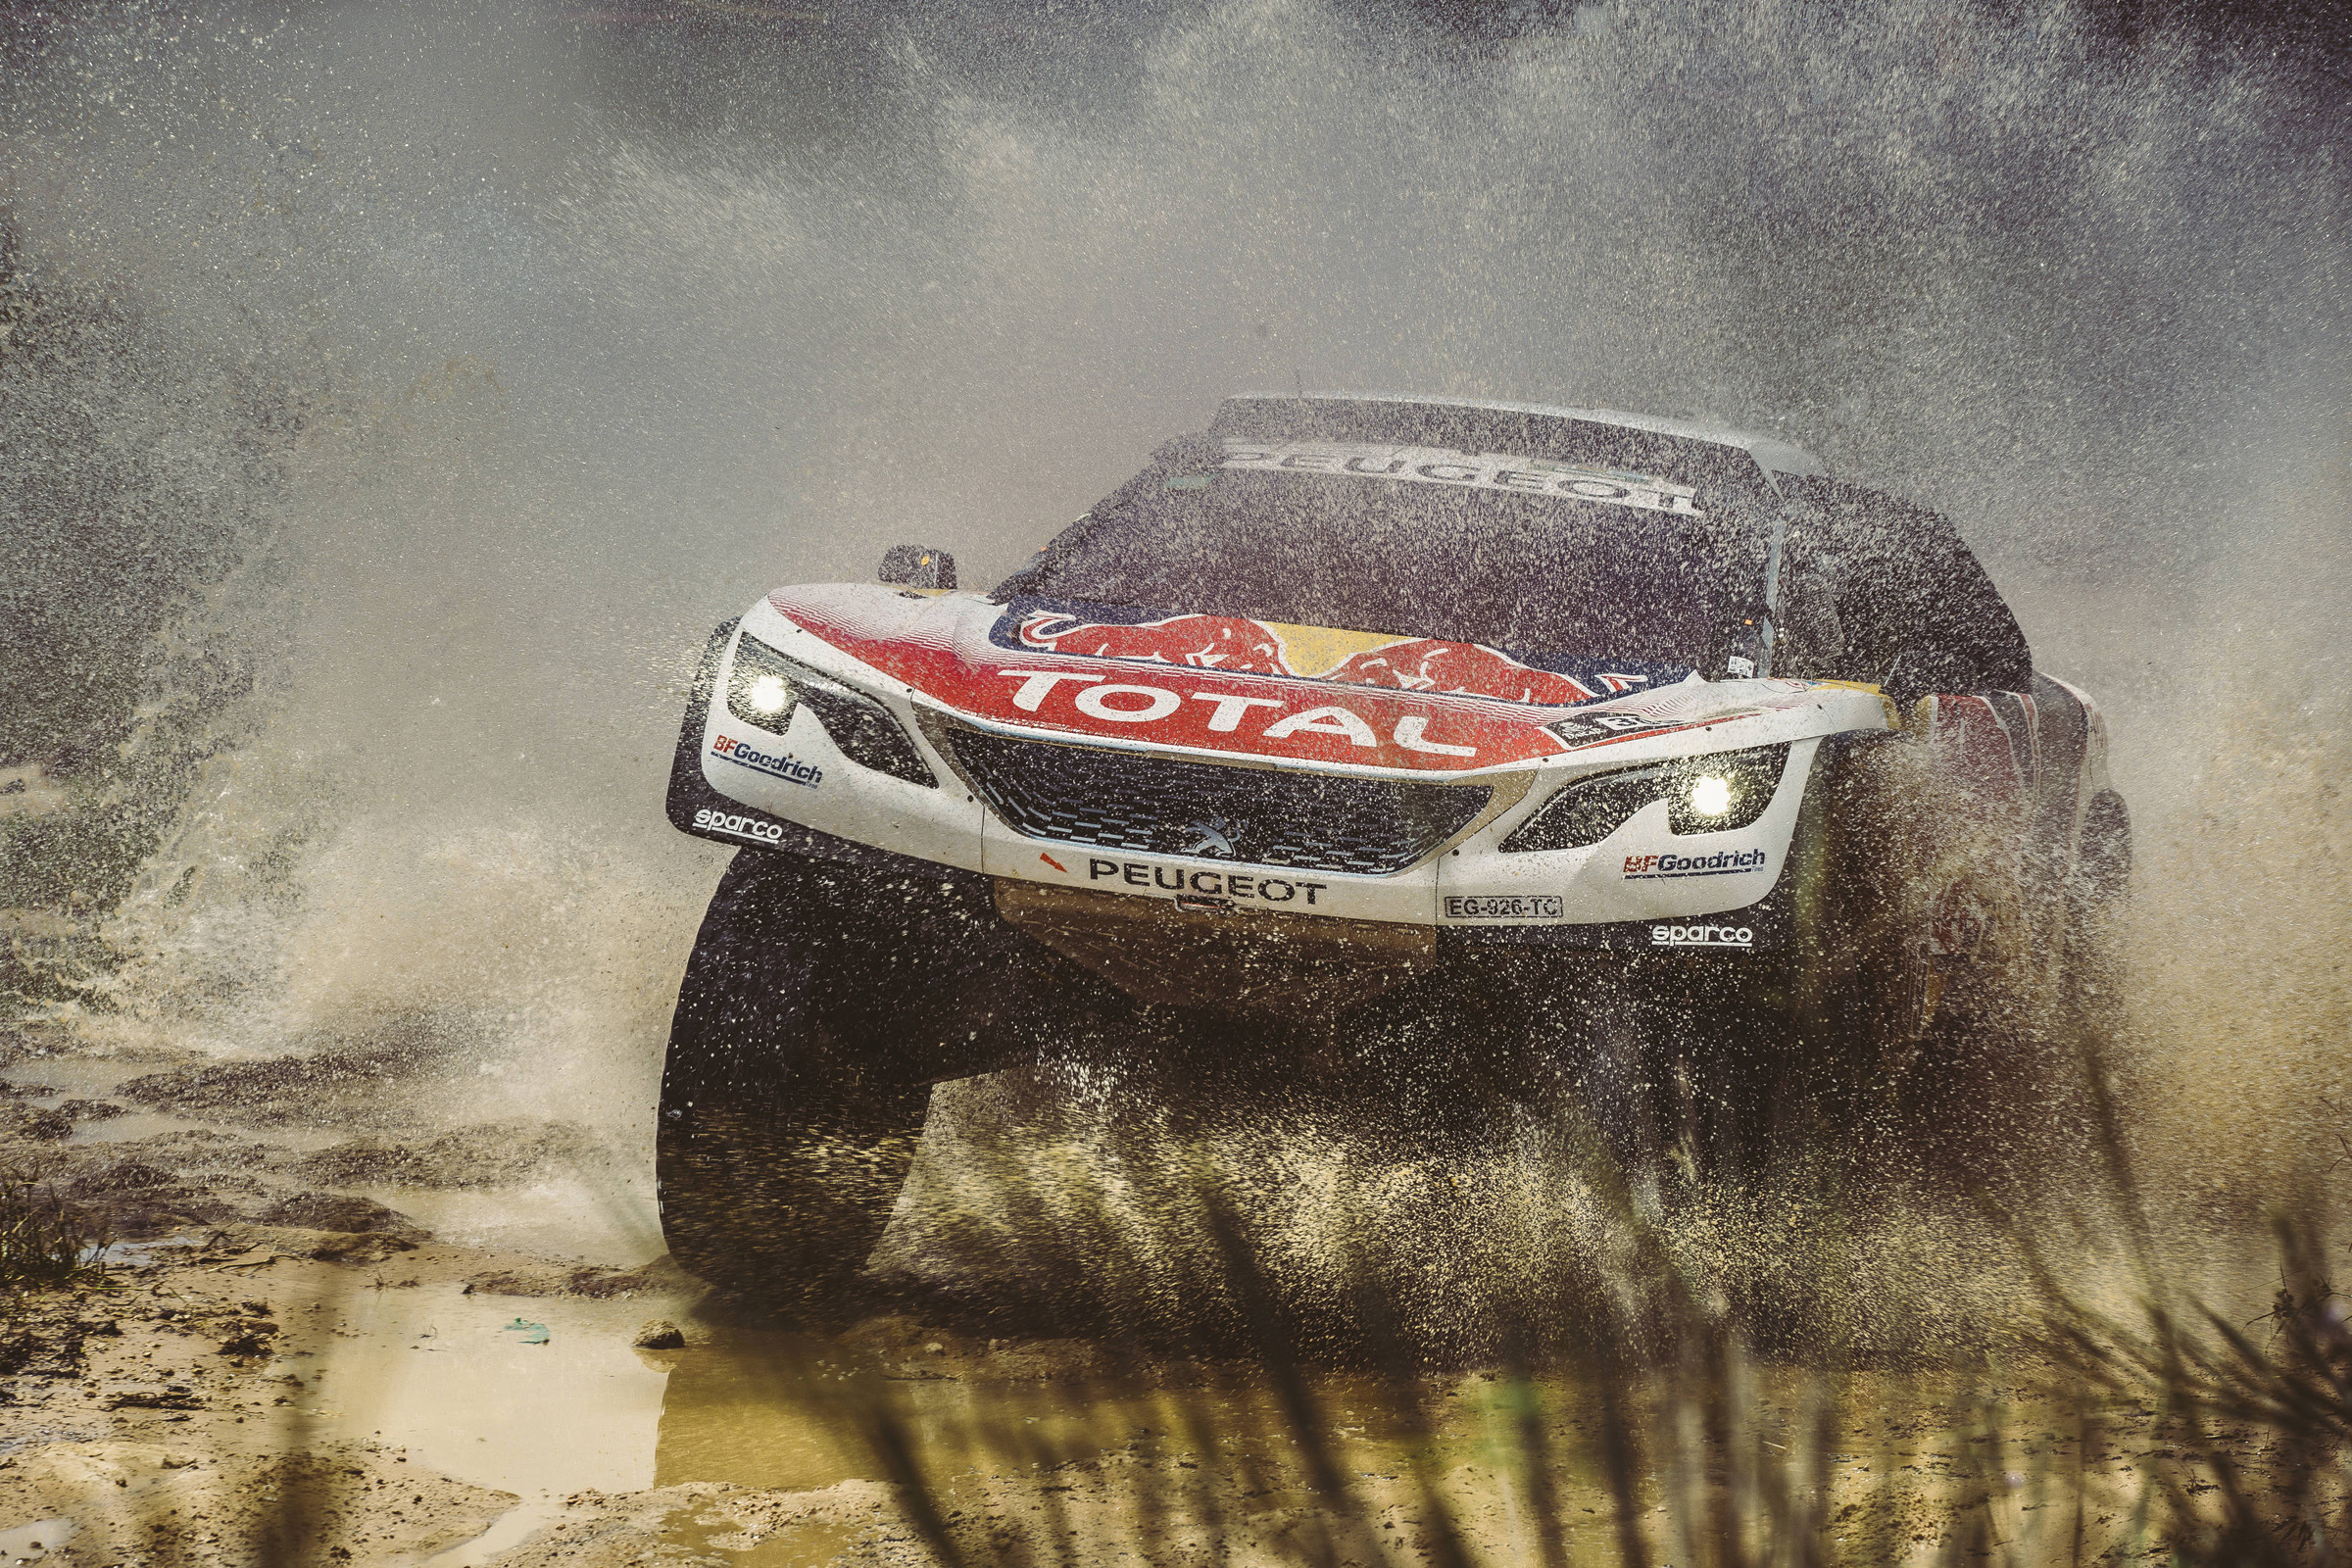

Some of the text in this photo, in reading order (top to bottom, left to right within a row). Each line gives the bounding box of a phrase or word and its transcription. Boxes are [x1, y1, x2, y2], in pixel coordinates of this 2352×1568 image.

[997, 669, 1478, 758] TOTAL
[713, 734, 823, 783] BFGoodrich
[694, 808, 783, 841] sparco
[1623, 848, 1766, 873] BFGoodrich
[1089, 858, 1327, 906] PEUGEOT
[1450, 899, 1558, 915] EG-926-TC
[1651, 924, 1752, 947] sparco
